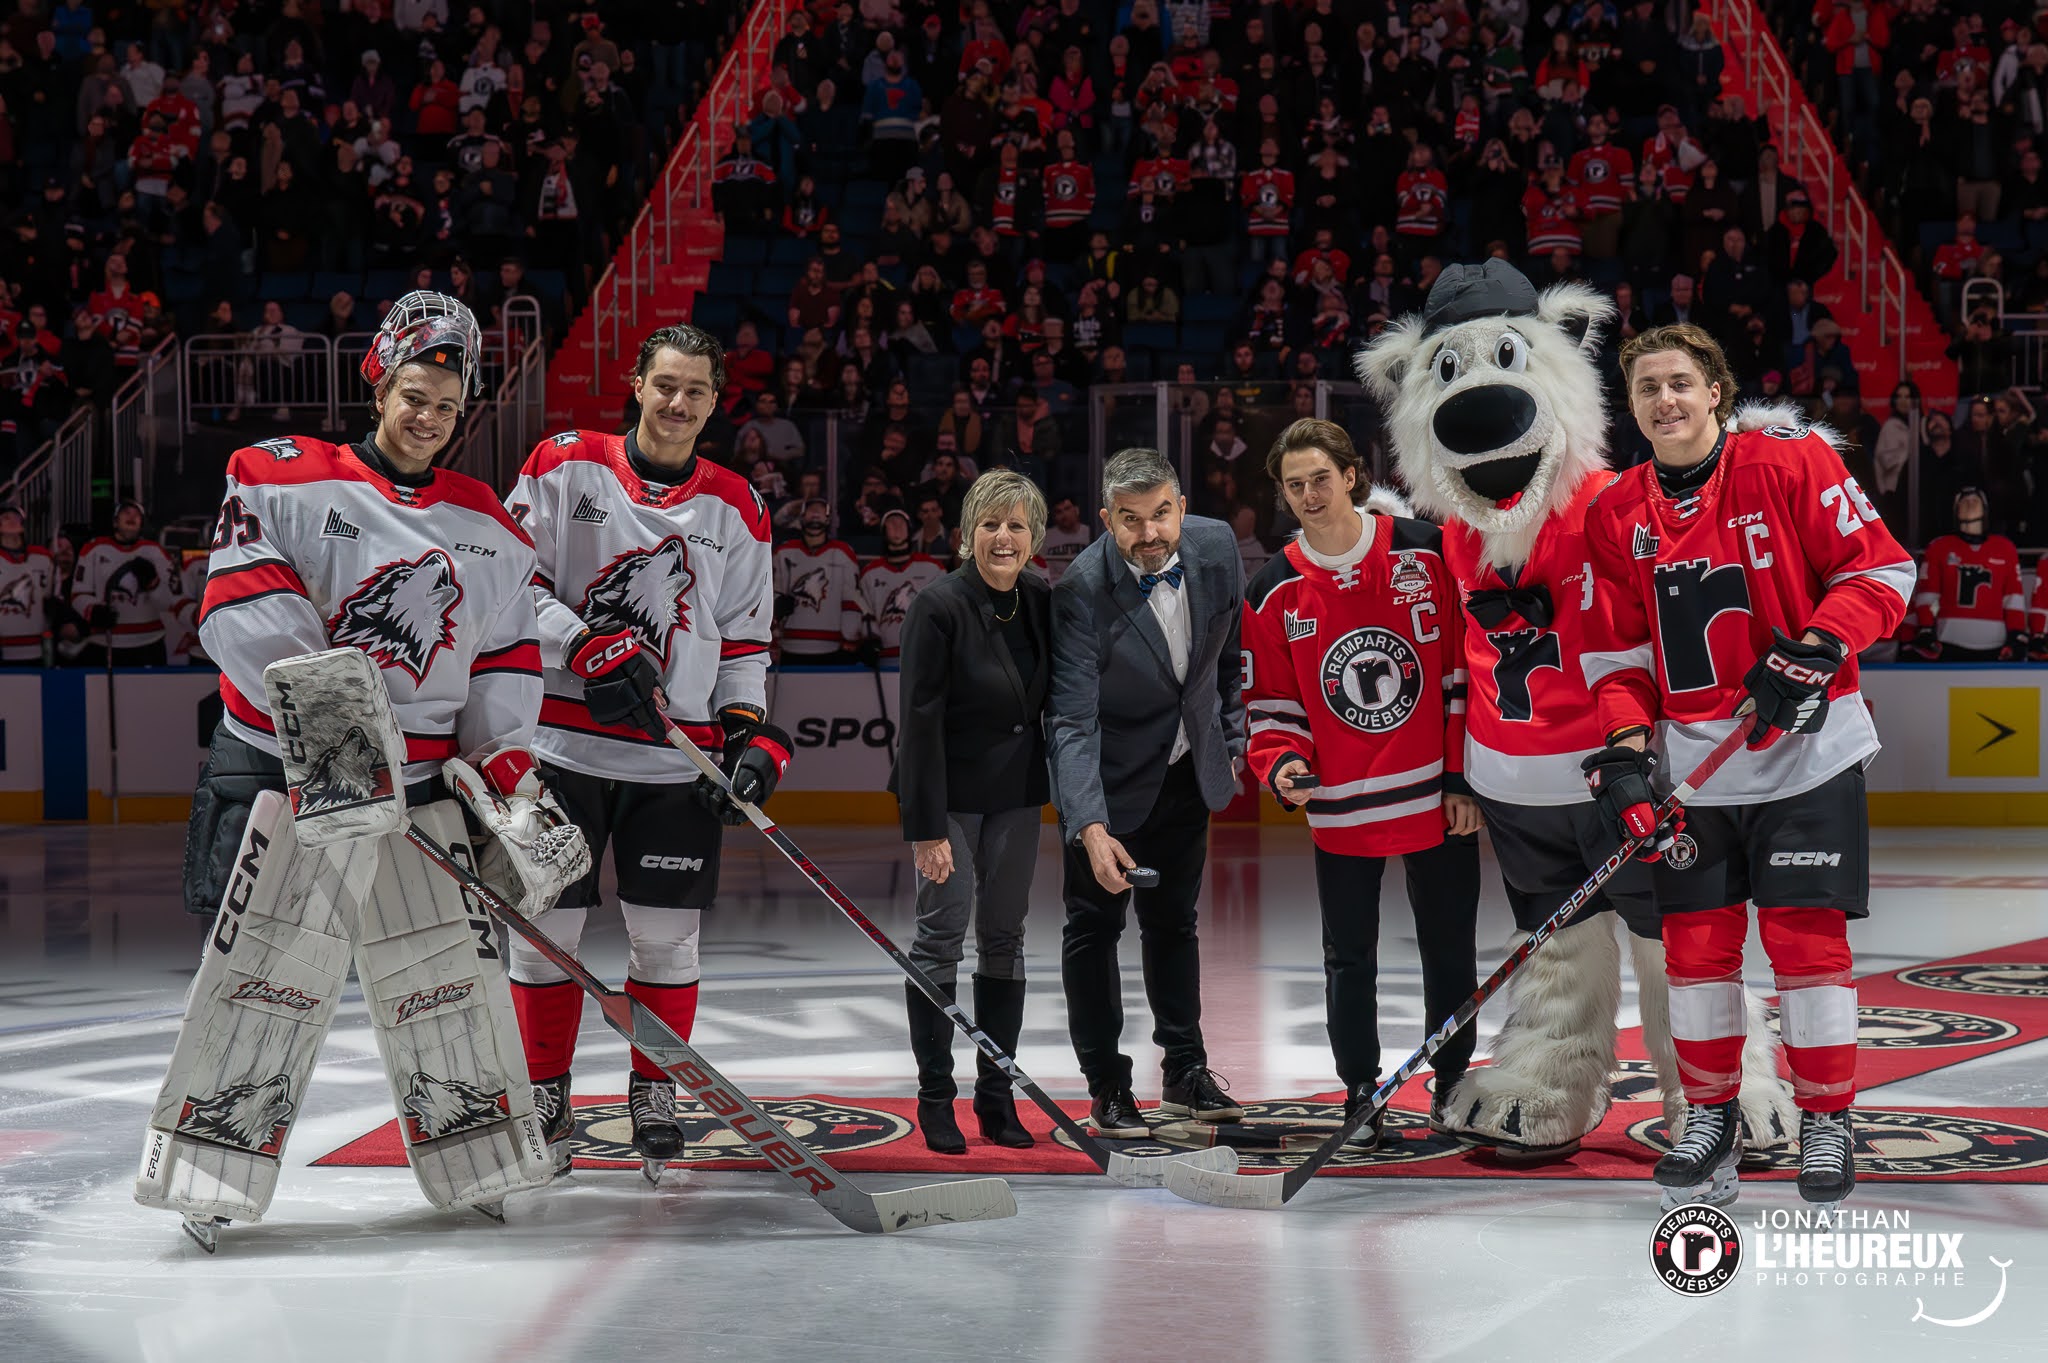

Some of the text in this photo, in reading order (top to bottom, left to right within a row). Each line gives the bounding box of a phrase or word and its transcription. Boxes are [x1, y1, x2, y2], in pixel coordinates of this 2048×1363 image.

[211, 495, 261, 553] 35
[1728, 511, 1763, 529] CCM
[455, 542, 497, 558] CCM
[688, 534, 724, 553] CCM
[1745, 523, 1774, 570] C
[1392, 590, 1432, 606] CCM
[1410, 601, 1441, 644] C
[1327, 633, 1407, 676] REMPARTS
[1766, 651, 1834, 686] CCM
[275, 681, 307, 764] CCM
[1345, 694, 1413, 728] QUÉBEC
[728, 728, 747, 741] CCM
[794, 717, 902, 748] SPO
[1631, 812, 1646, 833] CCM
[640, 854, 704, 871] CCM
[1769, 852, 1842, 867] CCM
[214, 827, 270, 956] CCM
[466, 882, 500, 909] MACH
[1527, 855, 1622, 955] JETSPEED
[230, 981, 320, 1016] Huskies
[395, 981, 474, 1026] Huskies
[944, 1004, 1034, 1088] CCM
[1372, 1014, 1459, 1109] CCM
